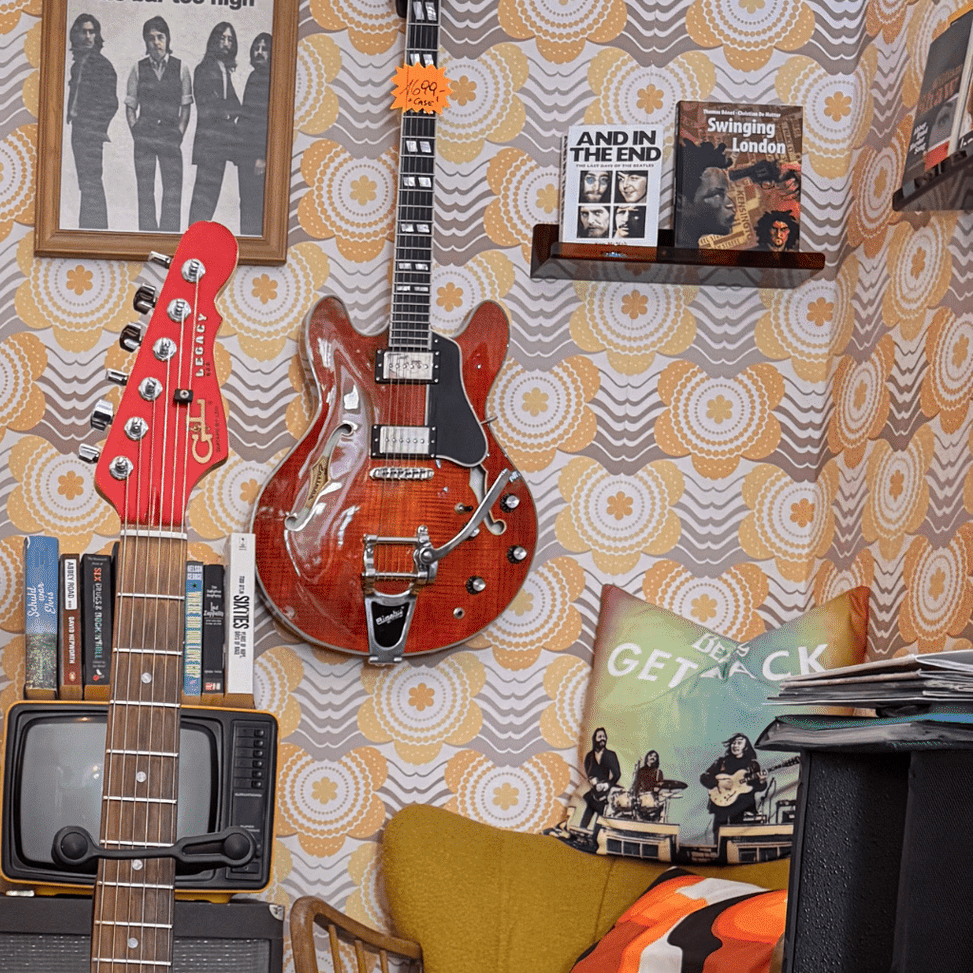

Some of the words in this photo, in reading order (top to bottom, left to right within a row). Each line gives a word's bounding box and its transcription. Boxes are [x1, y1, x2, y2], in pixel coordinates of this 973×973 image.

[576, 131, 629, 146] AND
[632, 130, 656, 145] IN
[707, 117, 775, 138] Swinging
[570, 147, 613, 162] THE
[616, 146, 662, 162] END
[732, 137, 786, 154] London
[194, 313, 207, 377] LEGACY
[66, 561, 75, 580] ABBEY
[66, 581, 75, 599] ROAD
[26, 585, 40, 618] Schuld
[43, 591, 56, 615] Elvis
[233, 595, 250, 630] SIXTIES
[607, 642, 699, 689] GET
